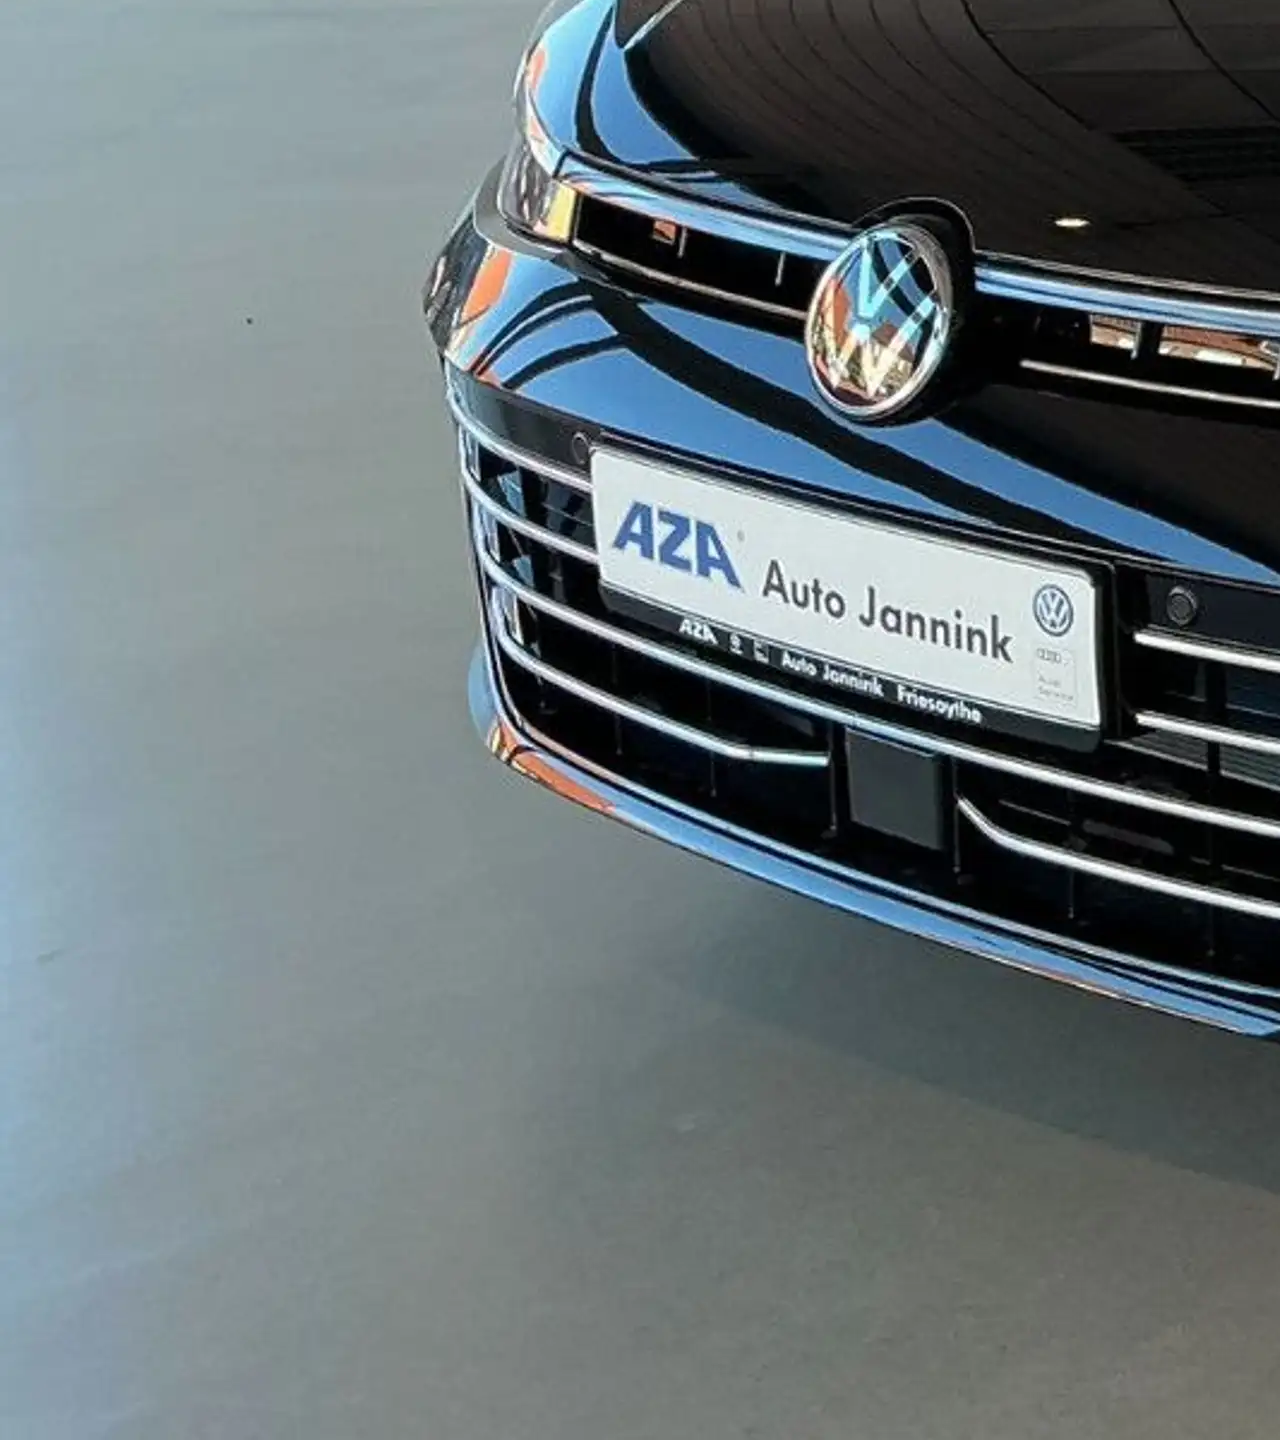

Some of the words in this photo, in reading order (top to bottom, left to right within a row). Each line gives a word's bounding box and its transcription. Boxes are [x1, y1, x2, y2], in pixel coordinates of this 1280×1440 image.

[612, 500, 743, 590] AZA
[762, 560, 846, 620] Auto
[859, 586, 1014, 664] Jannink
